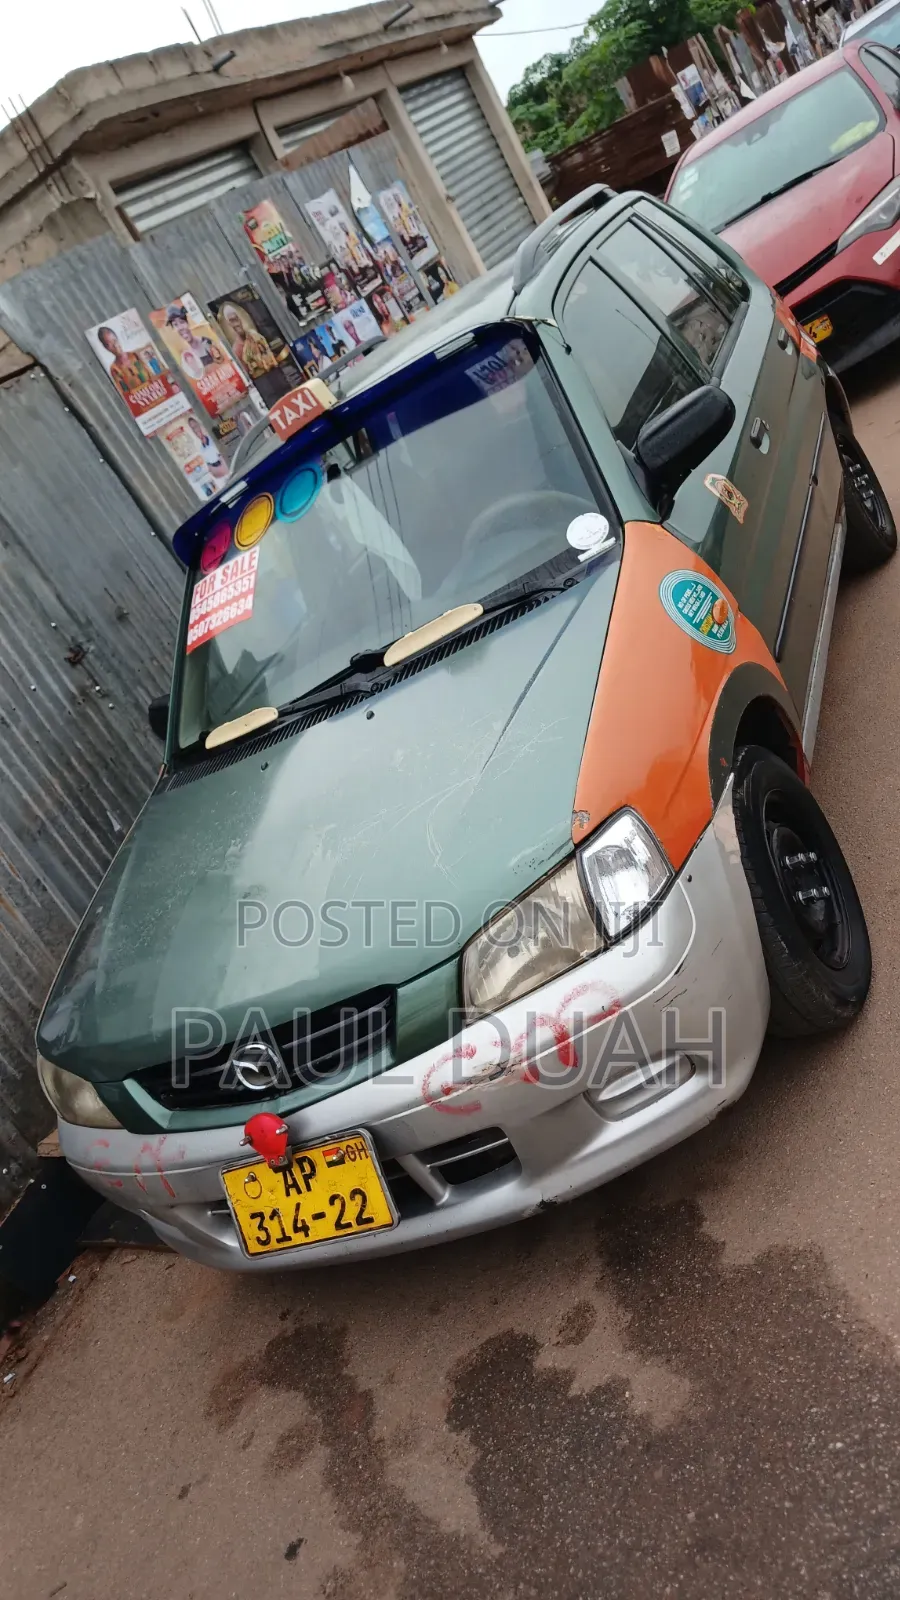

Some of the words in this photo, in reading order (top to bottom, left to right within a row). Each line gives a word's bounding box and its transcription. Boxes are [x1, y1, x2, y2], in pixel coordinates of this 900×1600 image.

[268, 389, 318, 430] TAXI
[194, 573, 217, 605] FOR
[220, 550, 257, 587] SALE
[345, 1141, 368, 1162] GH
[282, 1156, 317, 1197] AP
[250, 1187, 375, 1247] 314-22
